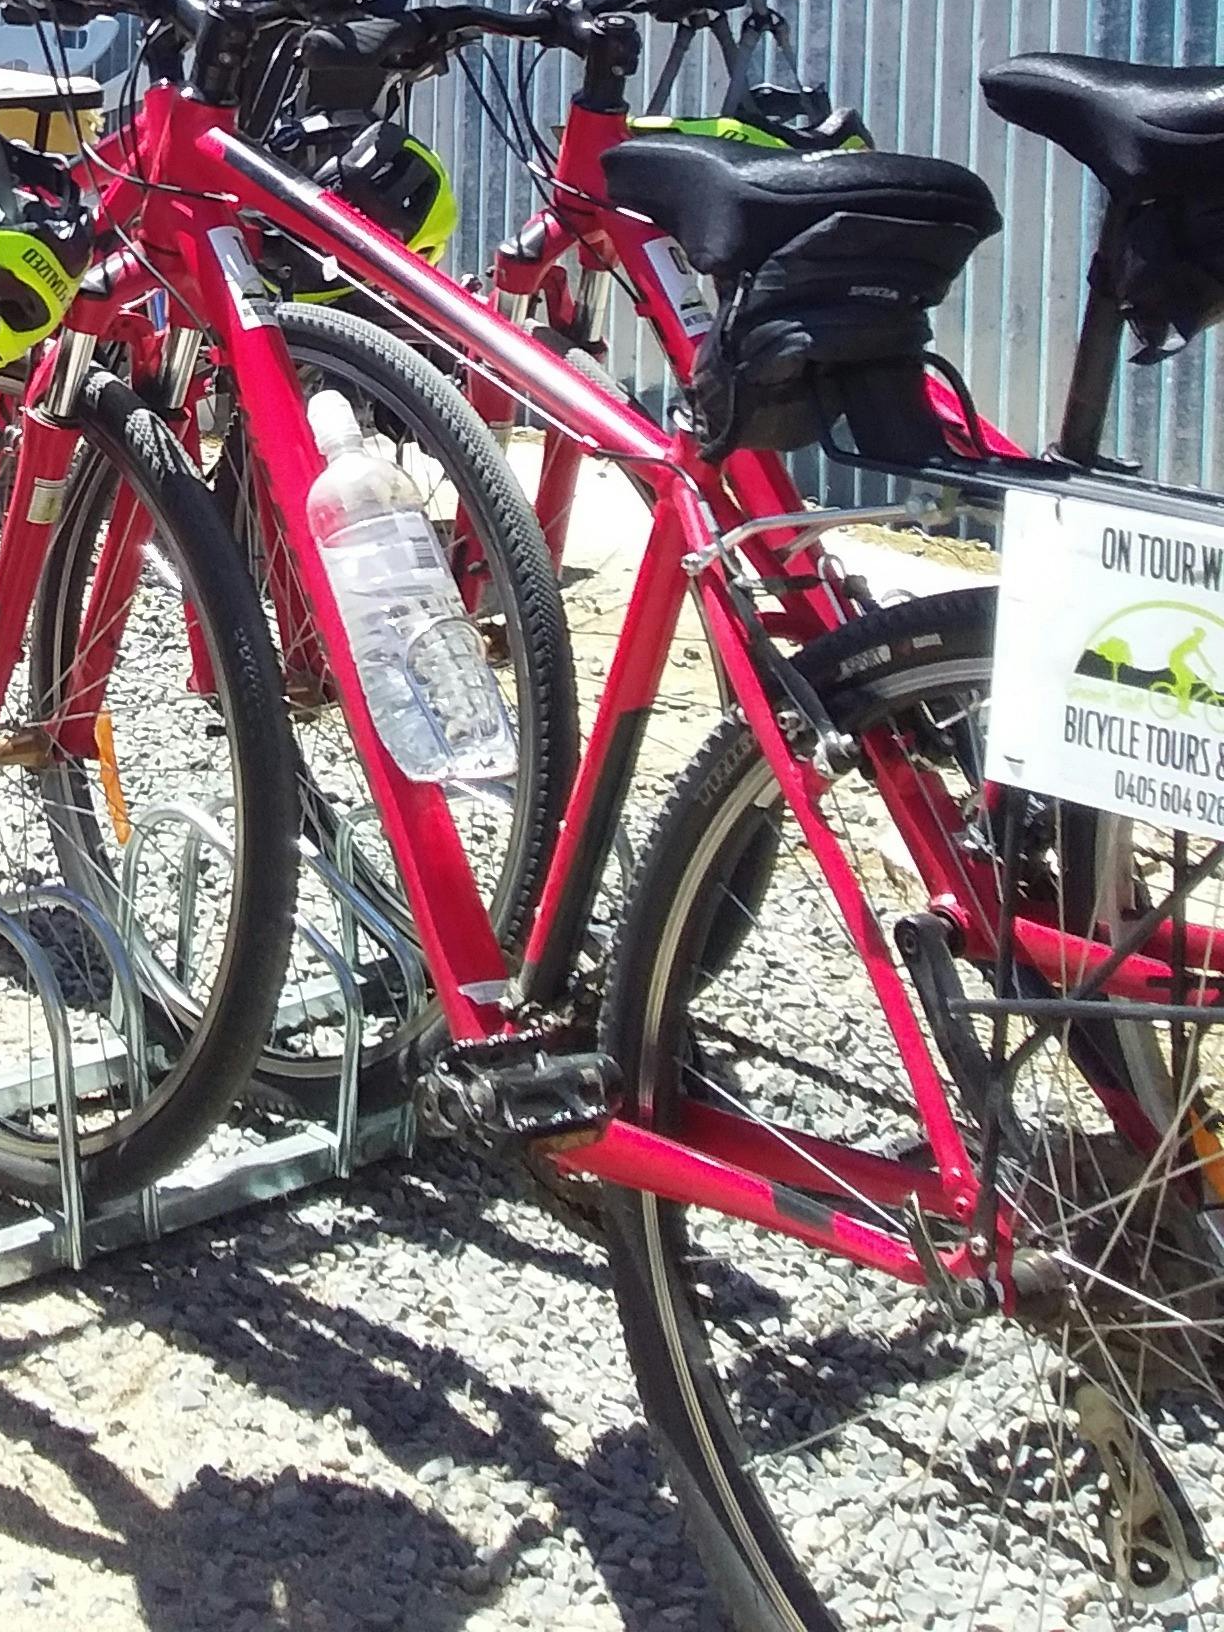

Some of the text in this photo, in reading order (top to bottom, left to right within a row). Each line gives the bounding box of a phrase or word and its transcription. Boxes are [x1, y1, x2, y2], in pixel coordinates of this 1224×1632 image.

[1101, 526, 1132, 574] ON
[1138, 532, 1196, 587] TOUR
[1064, 704, 1140, 760] BICYCLE
[1145, 723, 1211, 777] TOURS
[1114, 769, 1157, 809] 0405
[1160, 781, 1193, 819] 604
